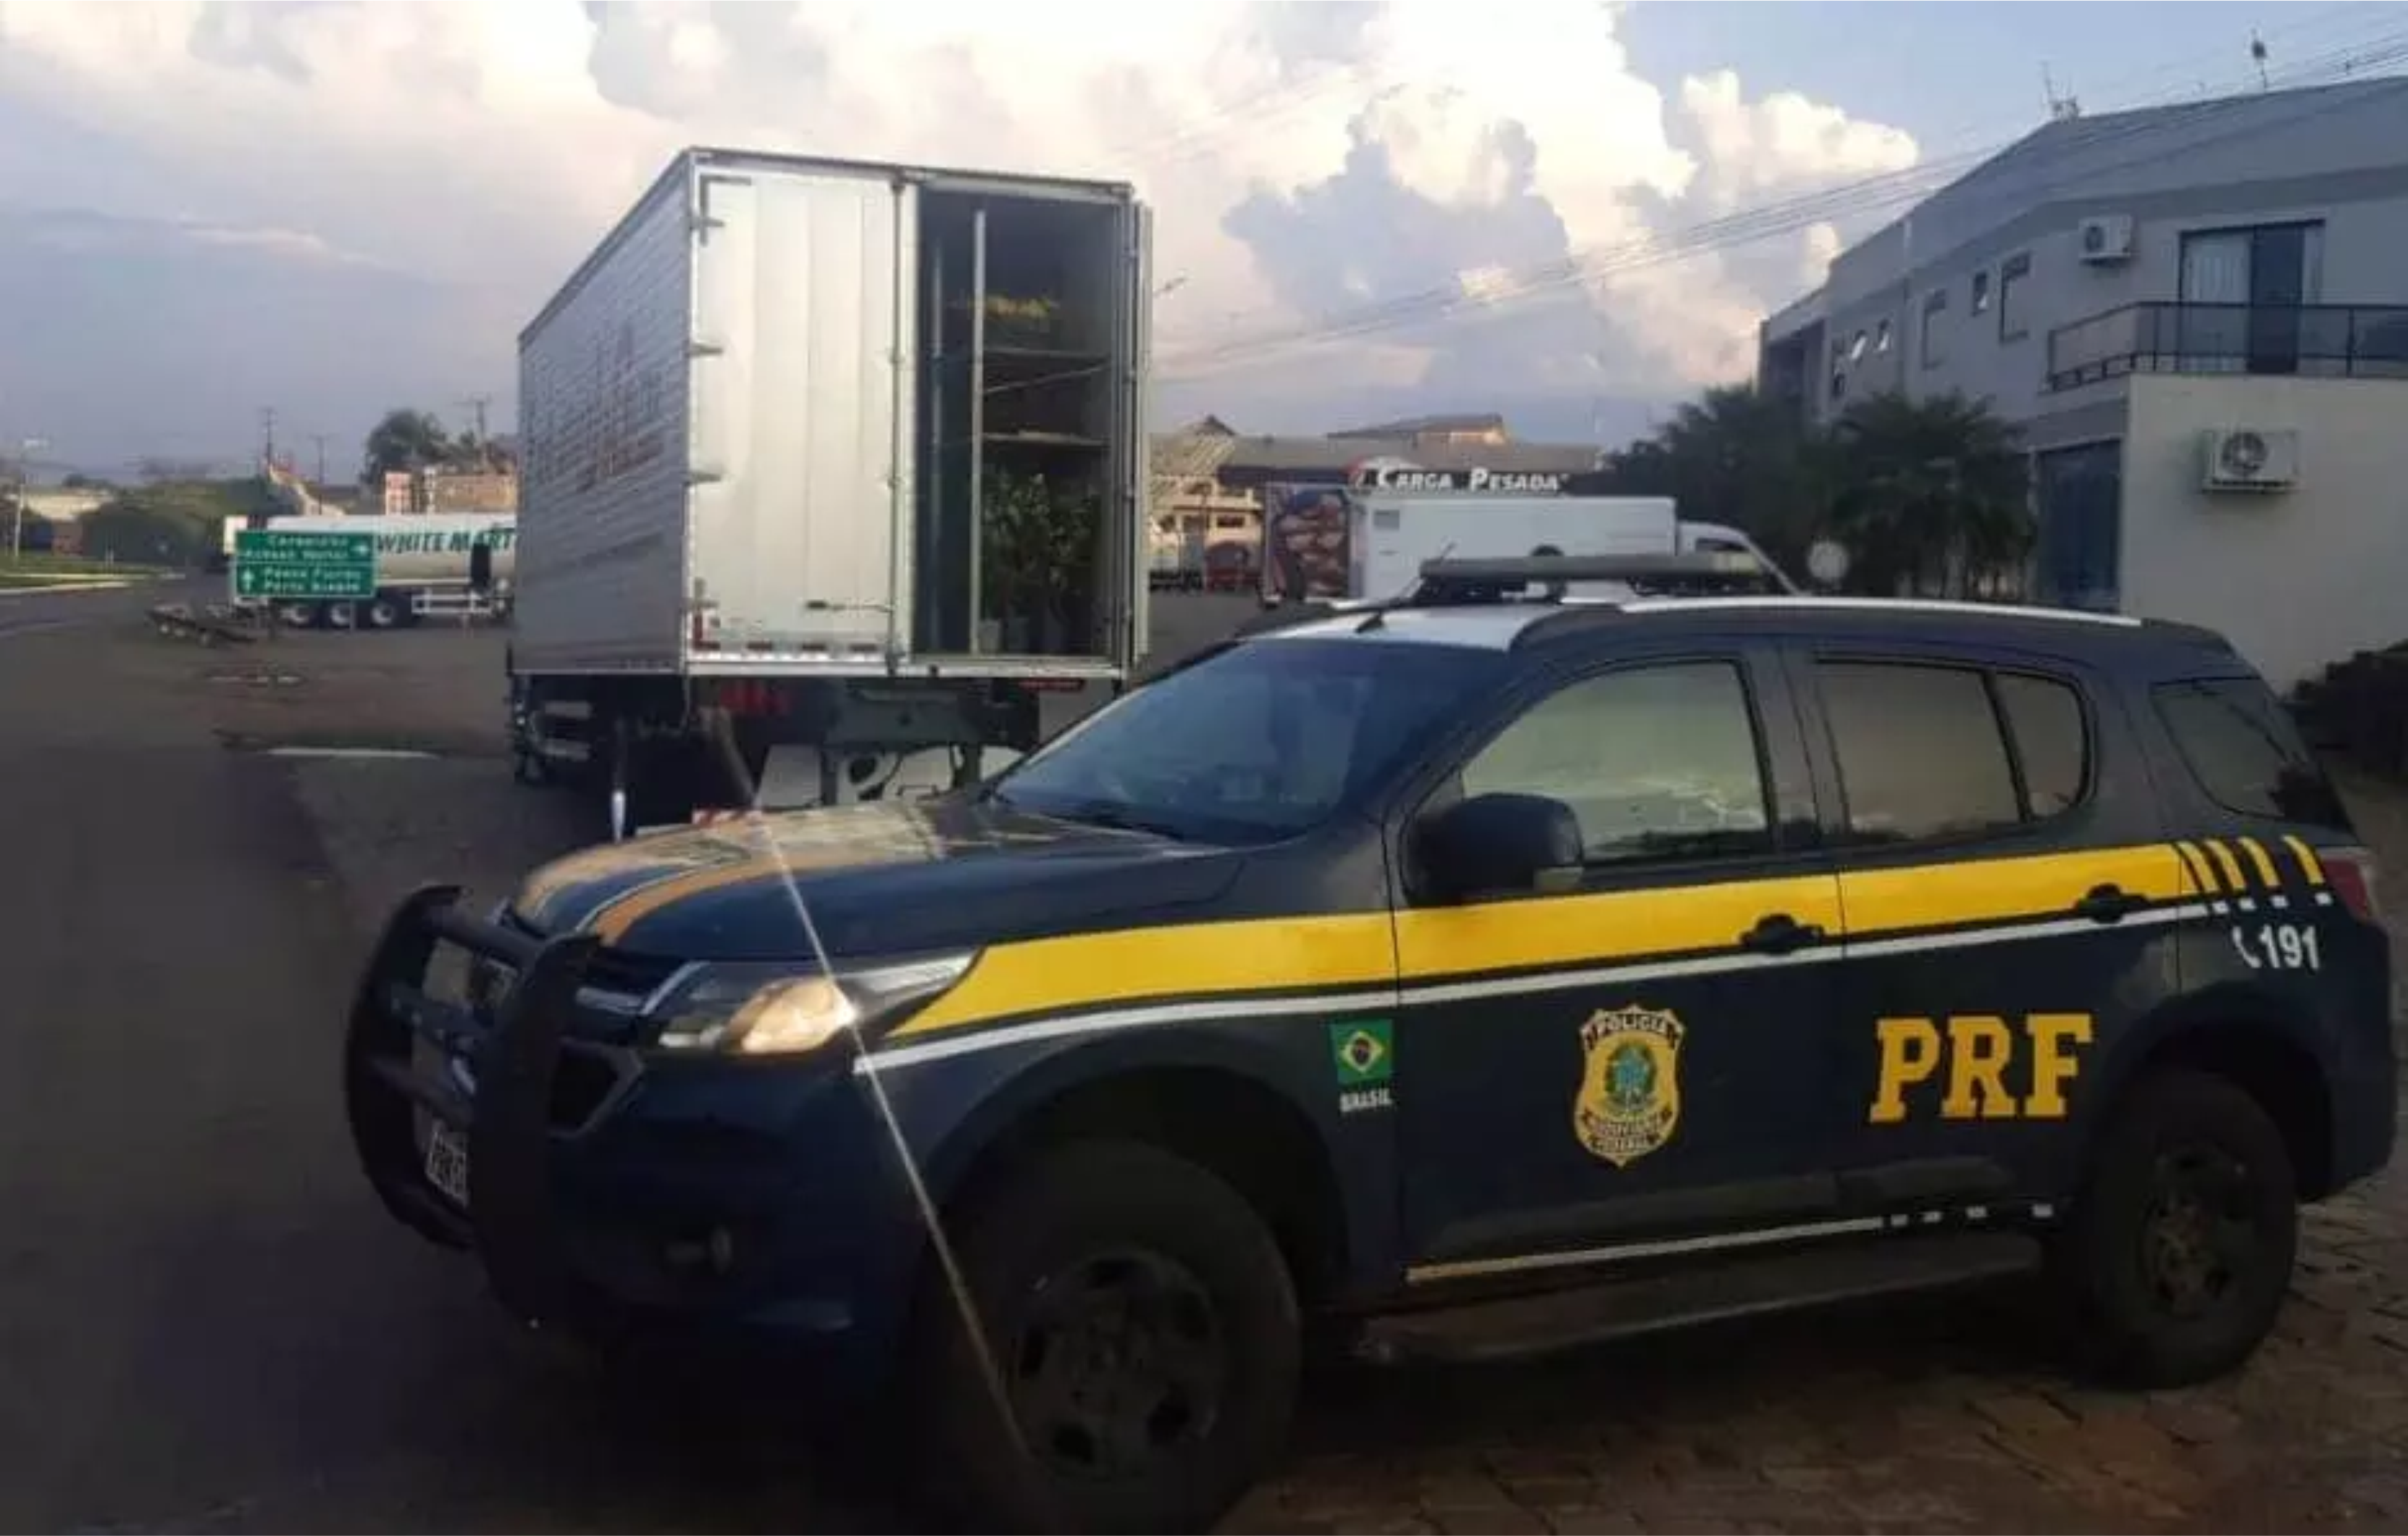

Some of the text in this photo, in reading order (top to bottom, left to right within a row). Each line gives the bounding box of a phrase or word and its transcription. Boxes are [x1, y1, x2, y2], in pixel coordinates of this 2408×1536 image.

[1376, 466, 1560, 491] CARGA PESADA
[377, 532, 447, 553] WHITE
[2259, 926, 2320, 970] 191
[1870, 1014, 2094, 1122] PRF
[1340, 1088, 1393, 1112] BRASIL
